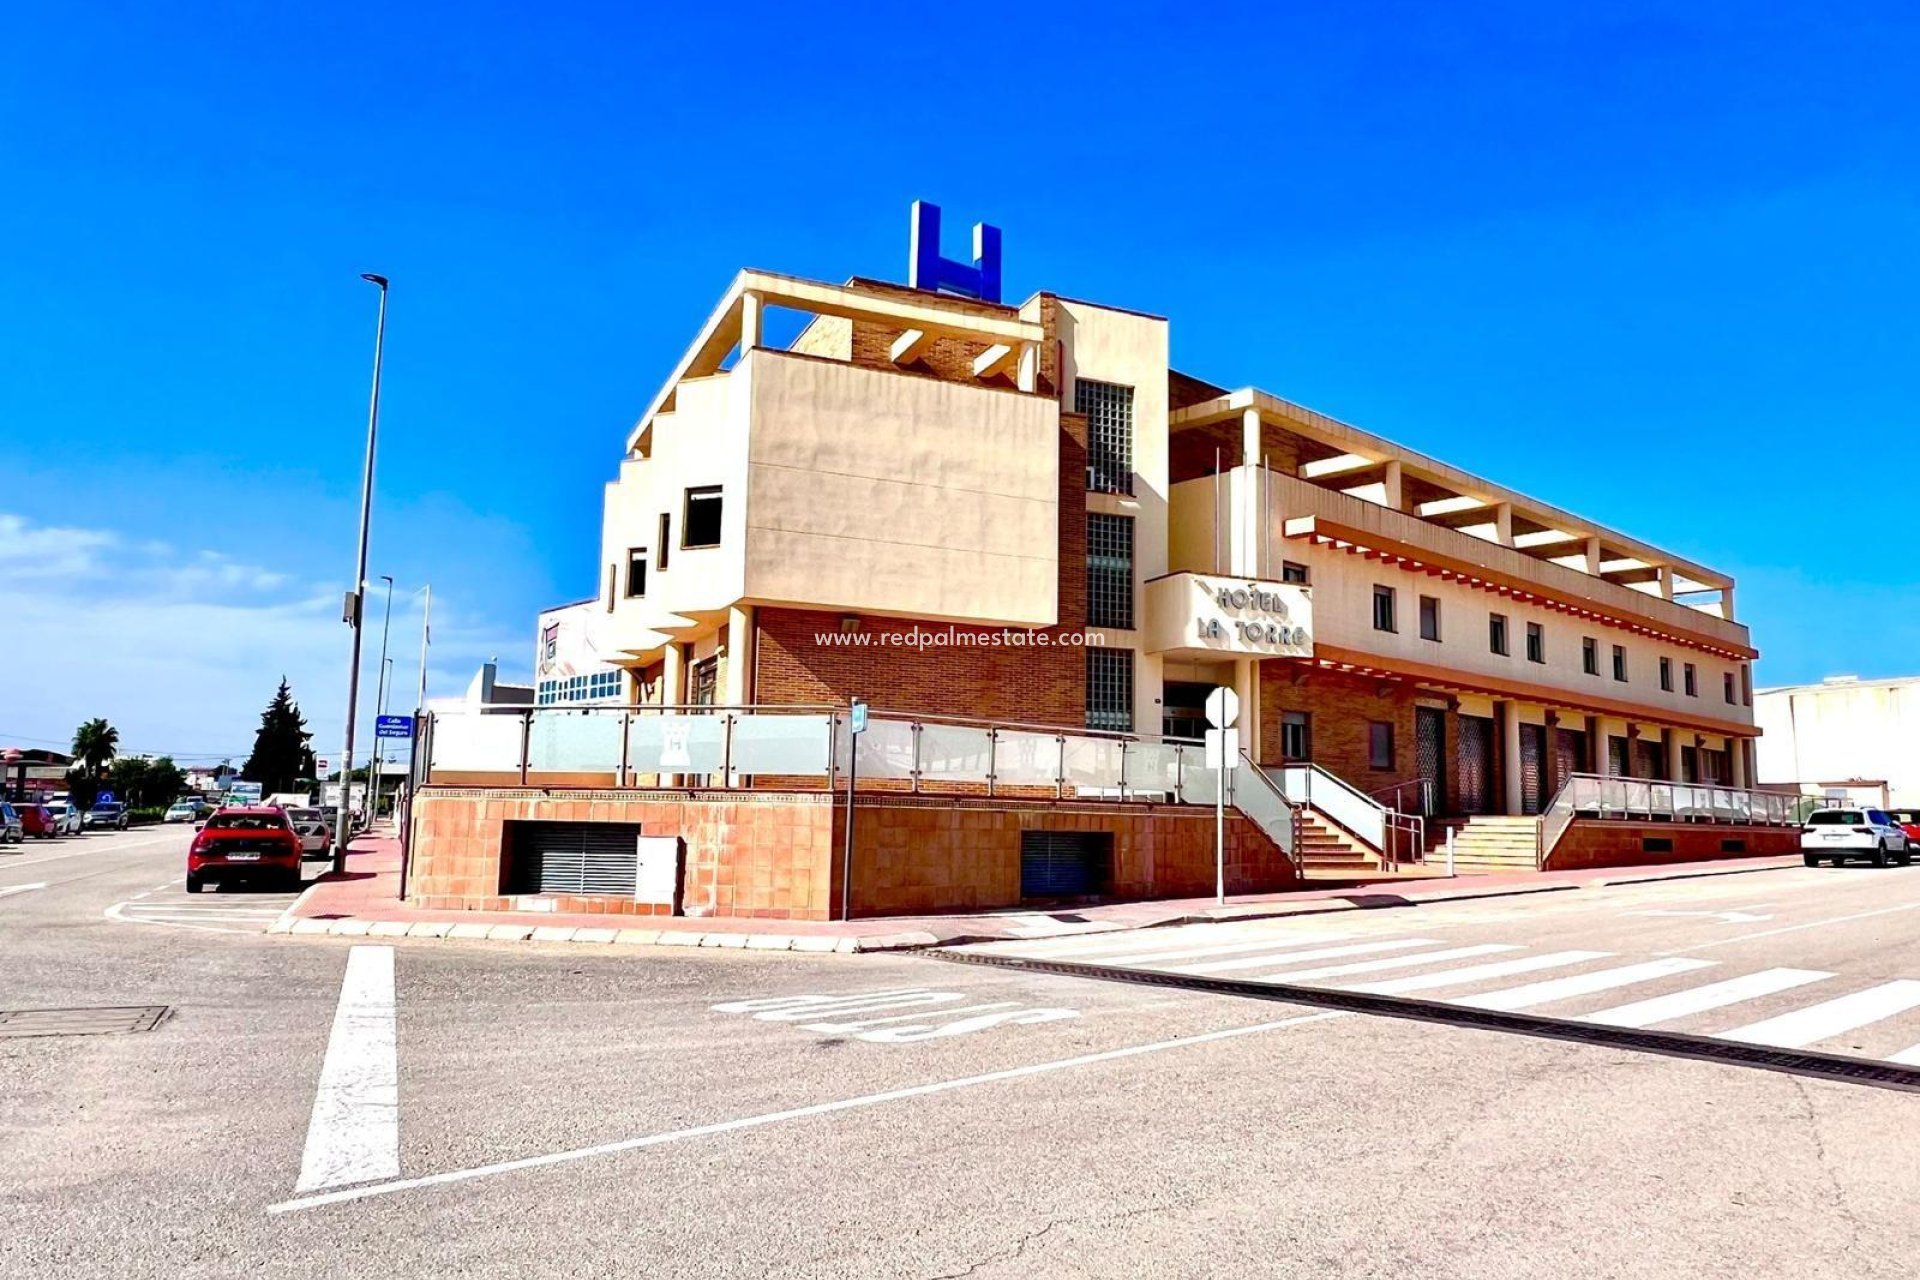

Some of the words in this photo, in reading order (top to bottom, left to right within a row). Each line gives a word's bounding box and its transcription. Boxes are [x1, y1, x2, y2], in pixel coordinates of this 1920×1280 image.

[1217, 587, 1284, 614] HOTEL
[1197, 616, 1221, 640] LA
[1234, 621, 1305, 646] TORRE
[710, 987, 1083, 1043] STOP
